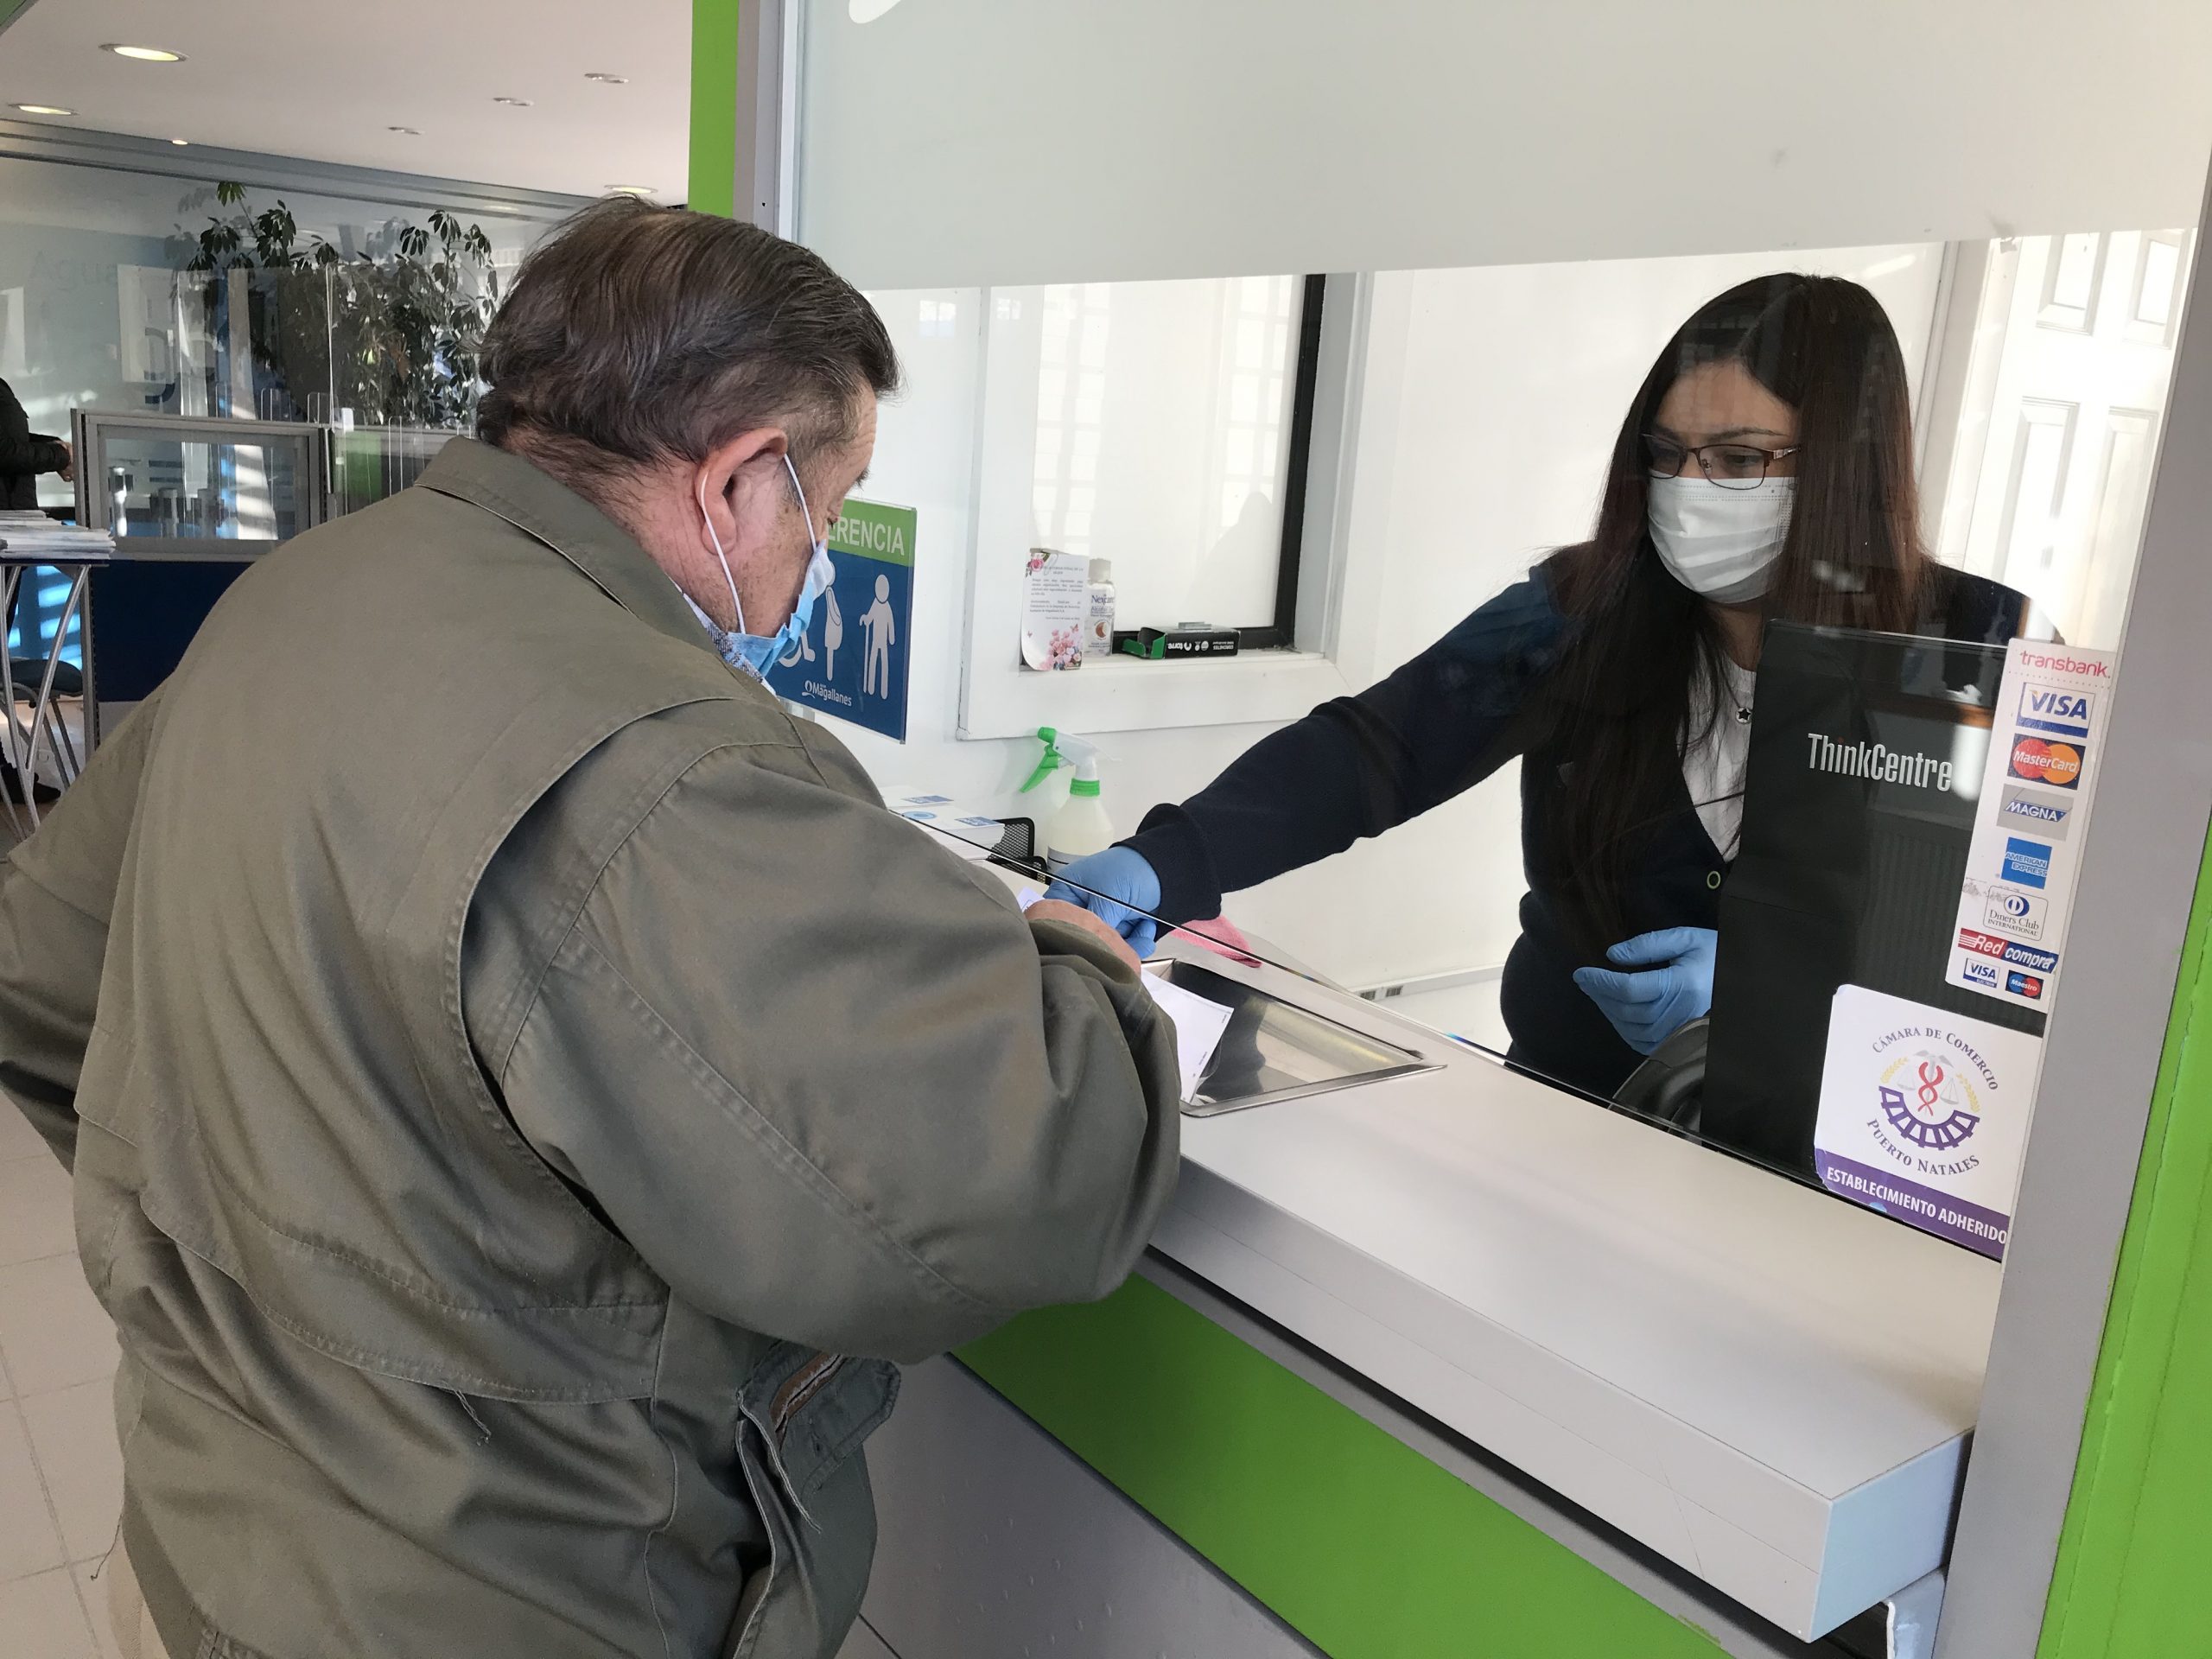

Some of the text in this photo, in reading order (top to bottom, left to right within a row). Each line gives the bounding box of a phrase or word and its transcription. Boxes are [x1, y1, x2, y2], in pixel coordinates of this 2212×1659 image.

[812, 682, 852, 707] Magallanes
[2029, 690, 2087, 720] VISA
[1808, 733, 1953, 792] ThinkCentre
[2012, 750, 2079, 774] MasterCard
[2005, 801, 2059, 823] MAGNA
[2005, 852, 2047, 868] AMERICAN
[2012, 862, 2048, 878] EXPRESS
[1987, 919, 2038, 937] INTERNATIONAL
[1989, 909, 2039, 931] Diners Club
[1974, 936, 2055, 971] Red compra
[1970, 963, 1997, 980] VISA
[2010, 979, 2038, 992] Maestro
[1925, 1027, 1942, 1040] DE
[1827, 1166, 2007, 1245] ESTABLECIMIENTO ADHERIDO
